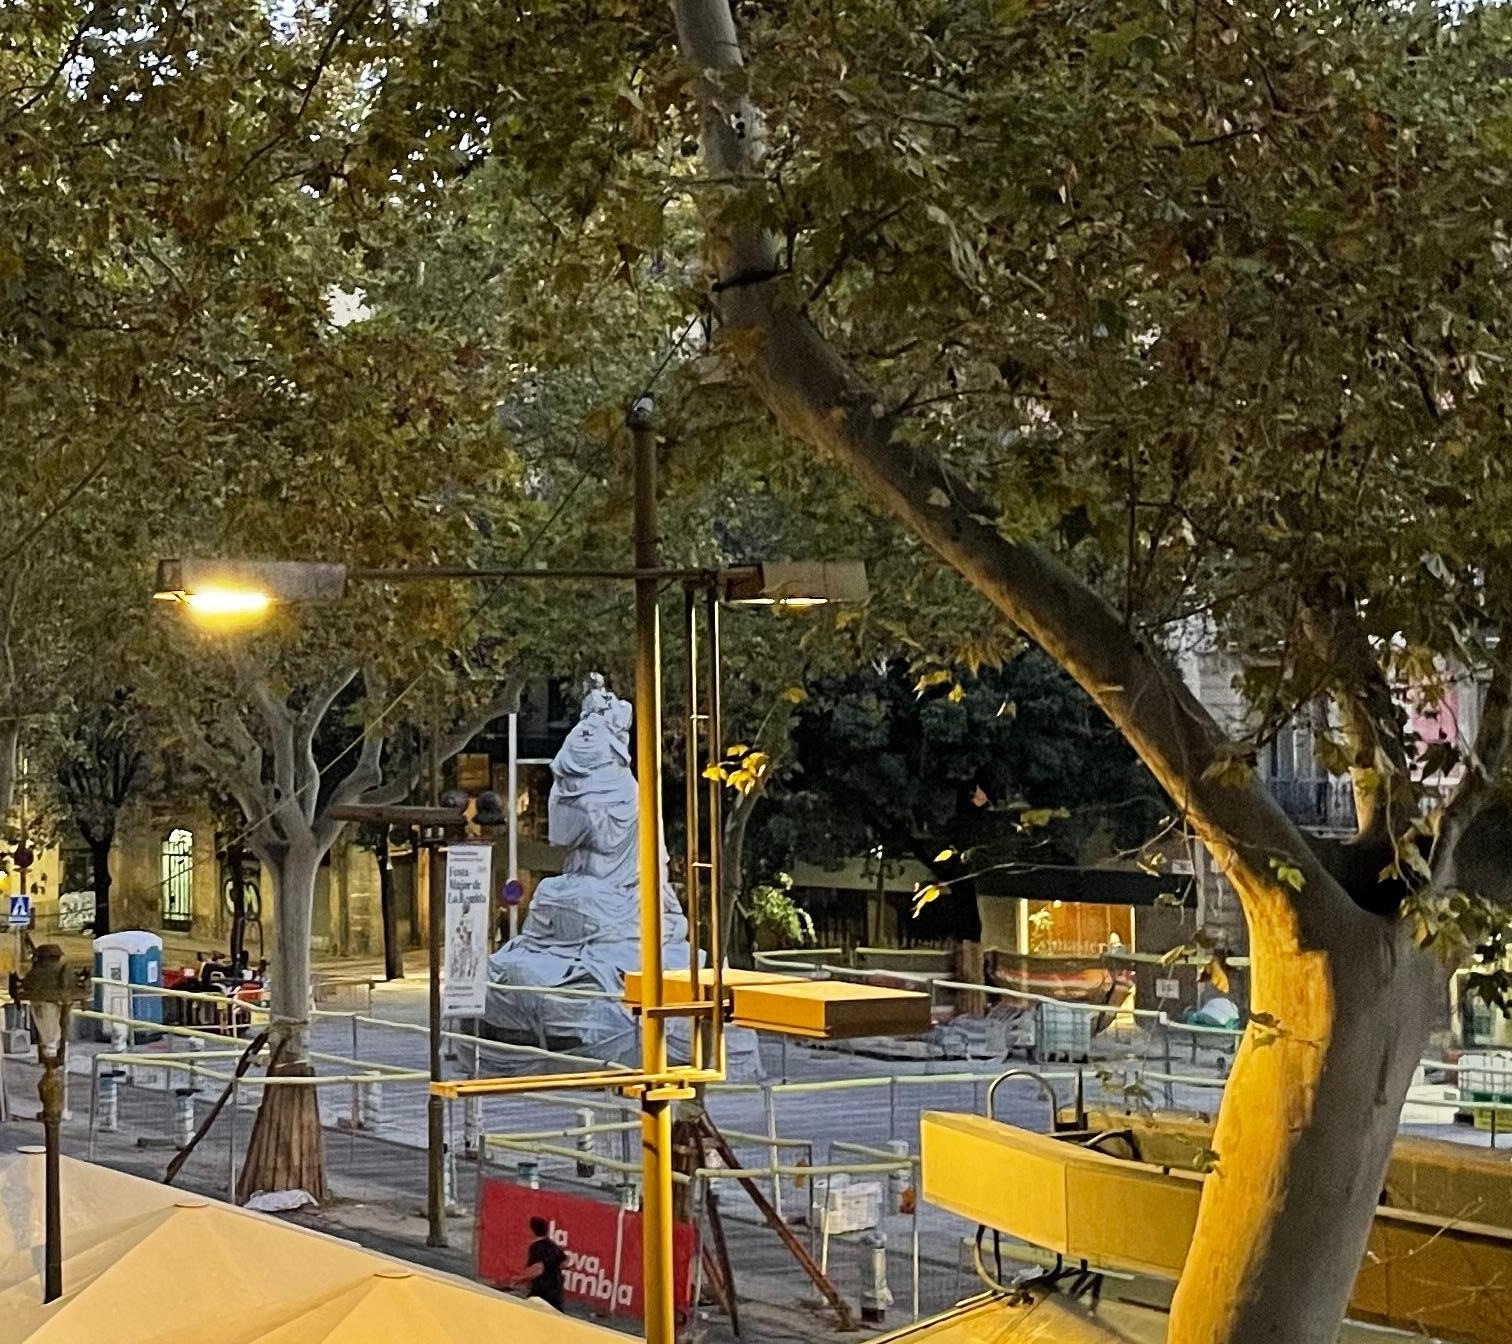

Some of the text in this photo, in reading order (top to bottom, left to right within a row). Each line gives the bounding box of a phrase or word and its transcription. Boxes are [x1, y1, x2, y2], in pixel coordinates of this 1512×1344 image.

[548, 1219, 569, 1247] la
[564, 1250, 600, 1273] ova
[561, 1267, 634, 1307] ambla
